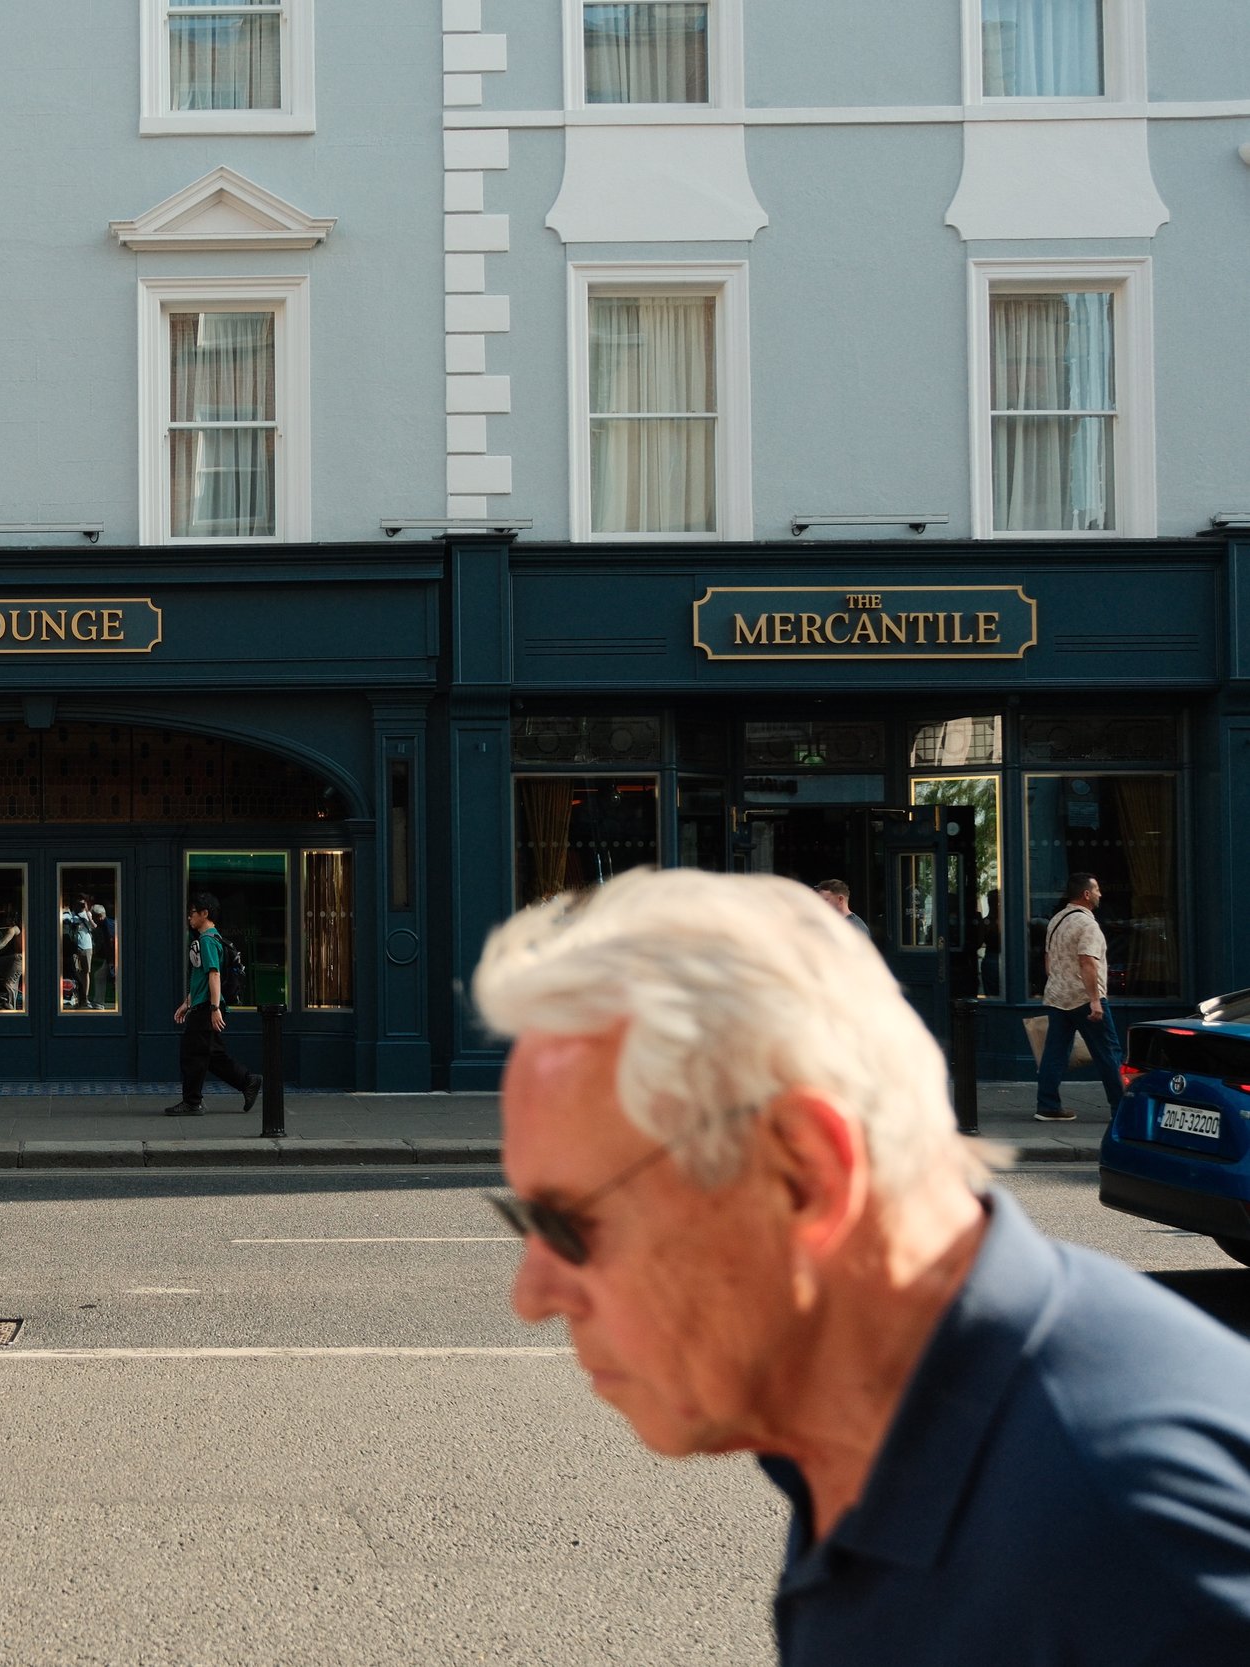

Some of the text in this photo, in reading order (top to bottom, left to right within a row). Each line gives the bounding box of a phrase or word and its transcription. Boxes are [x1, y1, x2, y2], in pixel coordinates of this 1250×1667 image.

[846, 593, 883, 609] THE
[734, 611, 1001, 645] MERCANTILE
[1164, 1110, 1219, 1134] 201-D-32200
